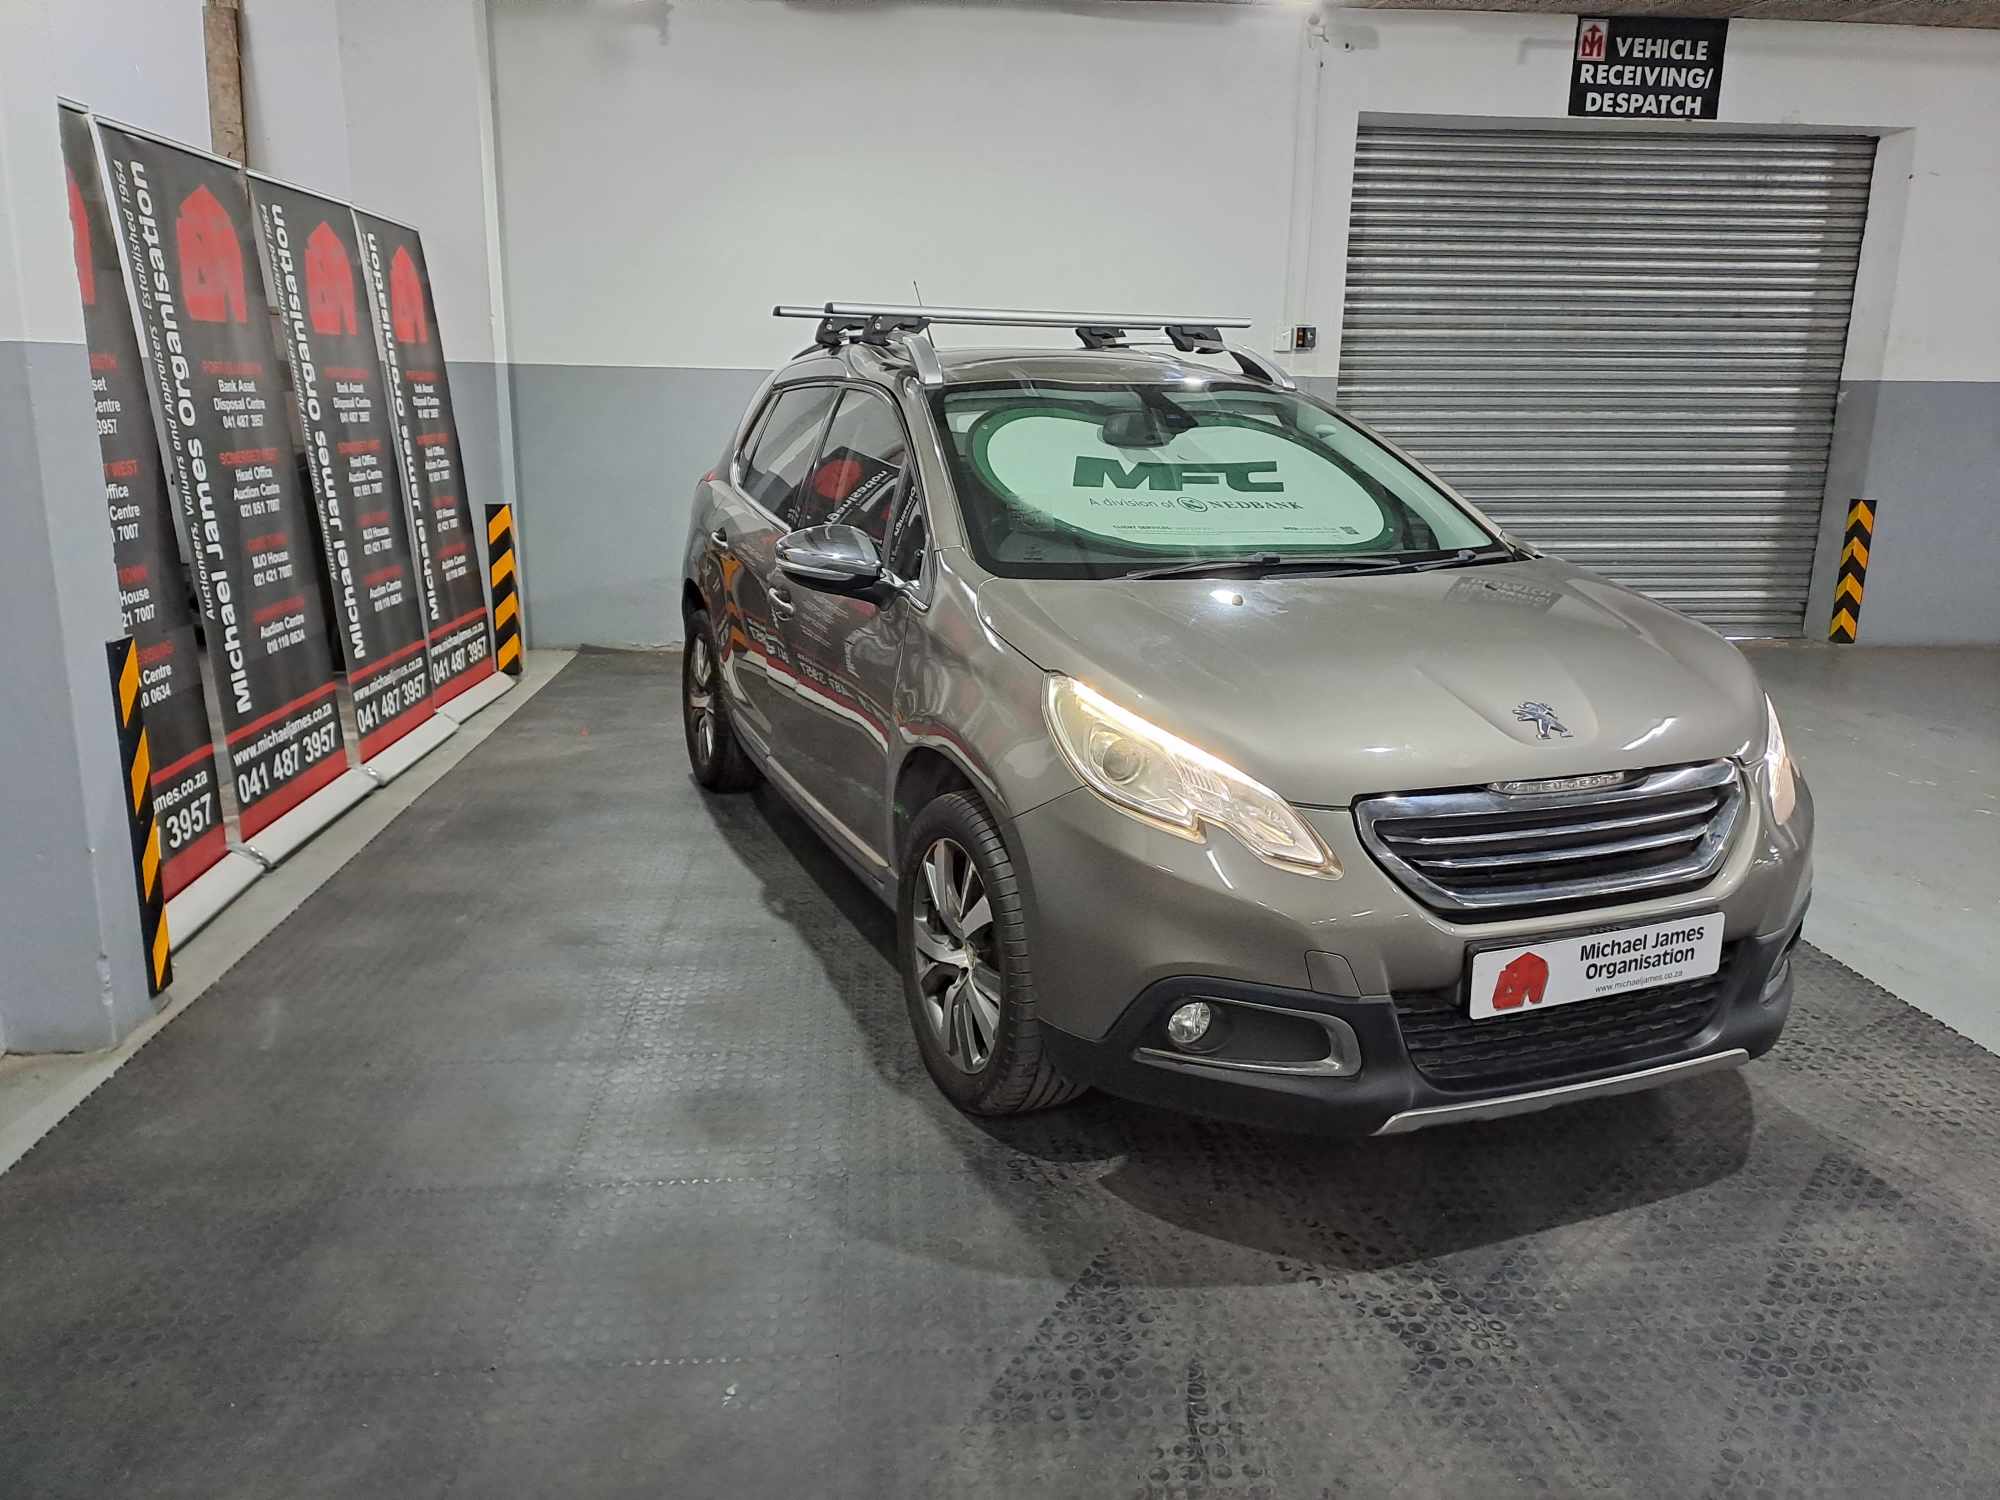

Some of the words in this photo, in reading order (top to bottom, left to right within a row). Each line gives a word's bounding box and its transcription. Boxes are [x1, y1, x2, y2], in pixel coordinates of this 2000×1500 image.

[1616, 37, 1709, 61] VEHICLE
[1579, 64, 1714, 89] RECEIVING/
[1585, 92, 1702, 116] DESPATCH
[113, 159, 130, 203] 1964
[122, 207, 152, 310] Established
[130, 160, 196, 427] Organisation
[271, 204, 321, 421] Organisation
[91, 376, 107, 391] set
[149, 324, 175, 415] Appraisers
[95, 399, 121, 413] entre
[166, 418, 181, 452] and
[176, 455, 195, 516] Valuers
[314, 430, 343, 532] James
[401, 424, 422, 511] James
[1072, 455, 1285, 492] MFC
[106, 484, 129, 499] ffice
[187, 438, 224, 560] James
[1103, 497, 1160, 508] division
[1207, 501, 1304, 510] NEDBANK
[109, 504, 141, 521] Centre
[116, 523, 139, 541] 7007
[190, 522, 216, 620] Auctioneers,
[415, 518, 440, 620] Michael
[120, 588, 150, 606] House
[121, 612, 133, 627] 21
[134, 604, 155, 623] 7007
[333, 540, 366, 660] Michael
[210, 570, 252, 714] Michael
[432, 656, 450, 685] 041
[451, 647, 466, 673] 487
[467, 635, 487, 663] 3957
[142, 664, 172, 685] Centre
[150, 682, 172, 703] 0634
[356, 700, 380, 733] 041
[381, 687, 400, 718] 487
[401, 672, 426, 706] 3957
[238, 762, 270, 803] 041
[273, 742, 299, 780] 487
[302, 721, 336, 763] 3957
[166, 792, 212, 848] 3957
[1580, 934, 1648, 961] Michael
[1651, 926, 1704, 949] James
[1586, 946, 1695, 979] Organisation
